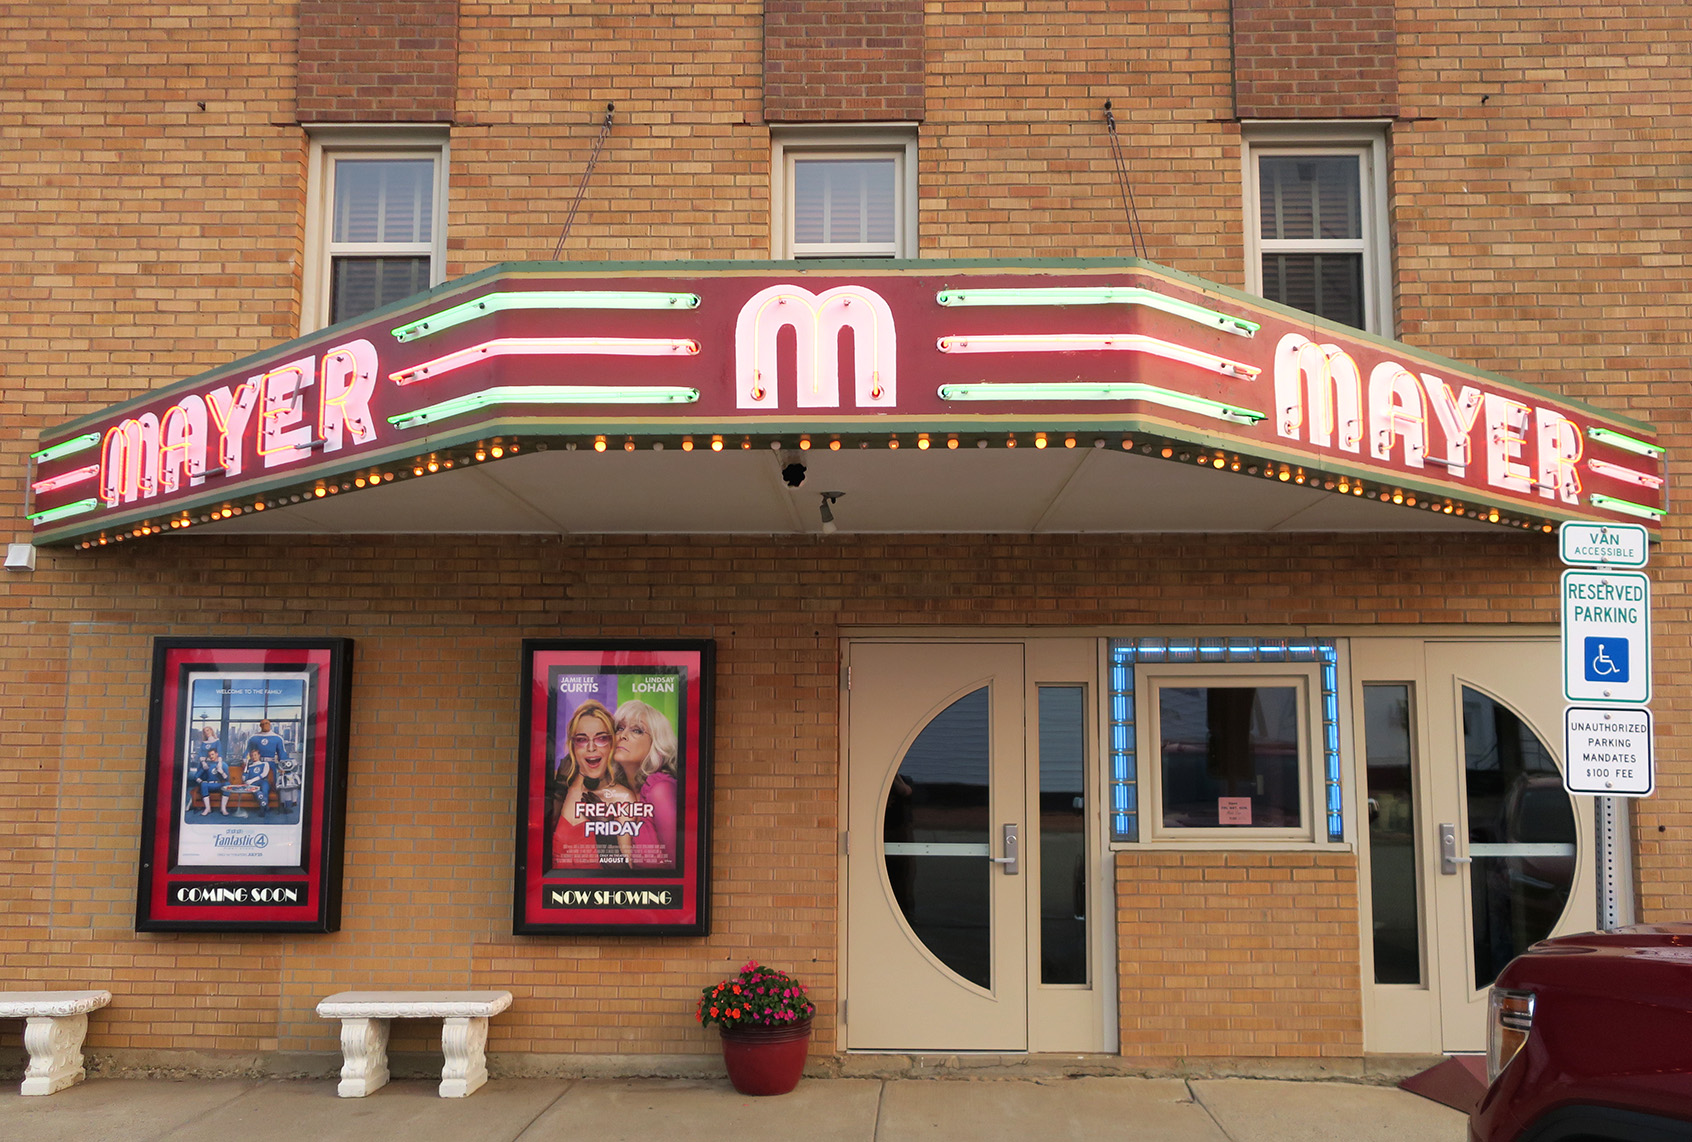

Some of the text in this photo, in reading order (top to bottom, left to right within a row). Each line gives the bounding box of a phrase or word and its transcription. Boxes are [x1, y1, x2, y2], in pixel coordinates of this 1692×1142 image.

[100, 338, 379, 509] MAYER
[1273, 332, 1584, 506] MAYER
[1590, 533, 1620, 546] VAN
[1574, 546, 1635, 558] ACCESSIBLE
[1568, 583, 1643, 602] RESERVED
[1574, 605, 1638, 624] PARKING
[560, 683, 599, 693] CURTIS
[632, 683, 675, 693] LOHAN
[1571, 722, 1647, 733] UNAUTHORIZED
[1588, 738, 1631, 748] PARKING
[1583, 753, 1637, 763] MANDATES
[1586, 768, 1634, 779] $100 FEE
[575, 802, 654, 818] FREAKIER
[585, 820, 644, 837] FRIDAY
[214, 834, 254, 848] Fantastic
[177, 887, 298, 903] COMING SOON
[551, 890, 673, 906] NOW SHOWING
